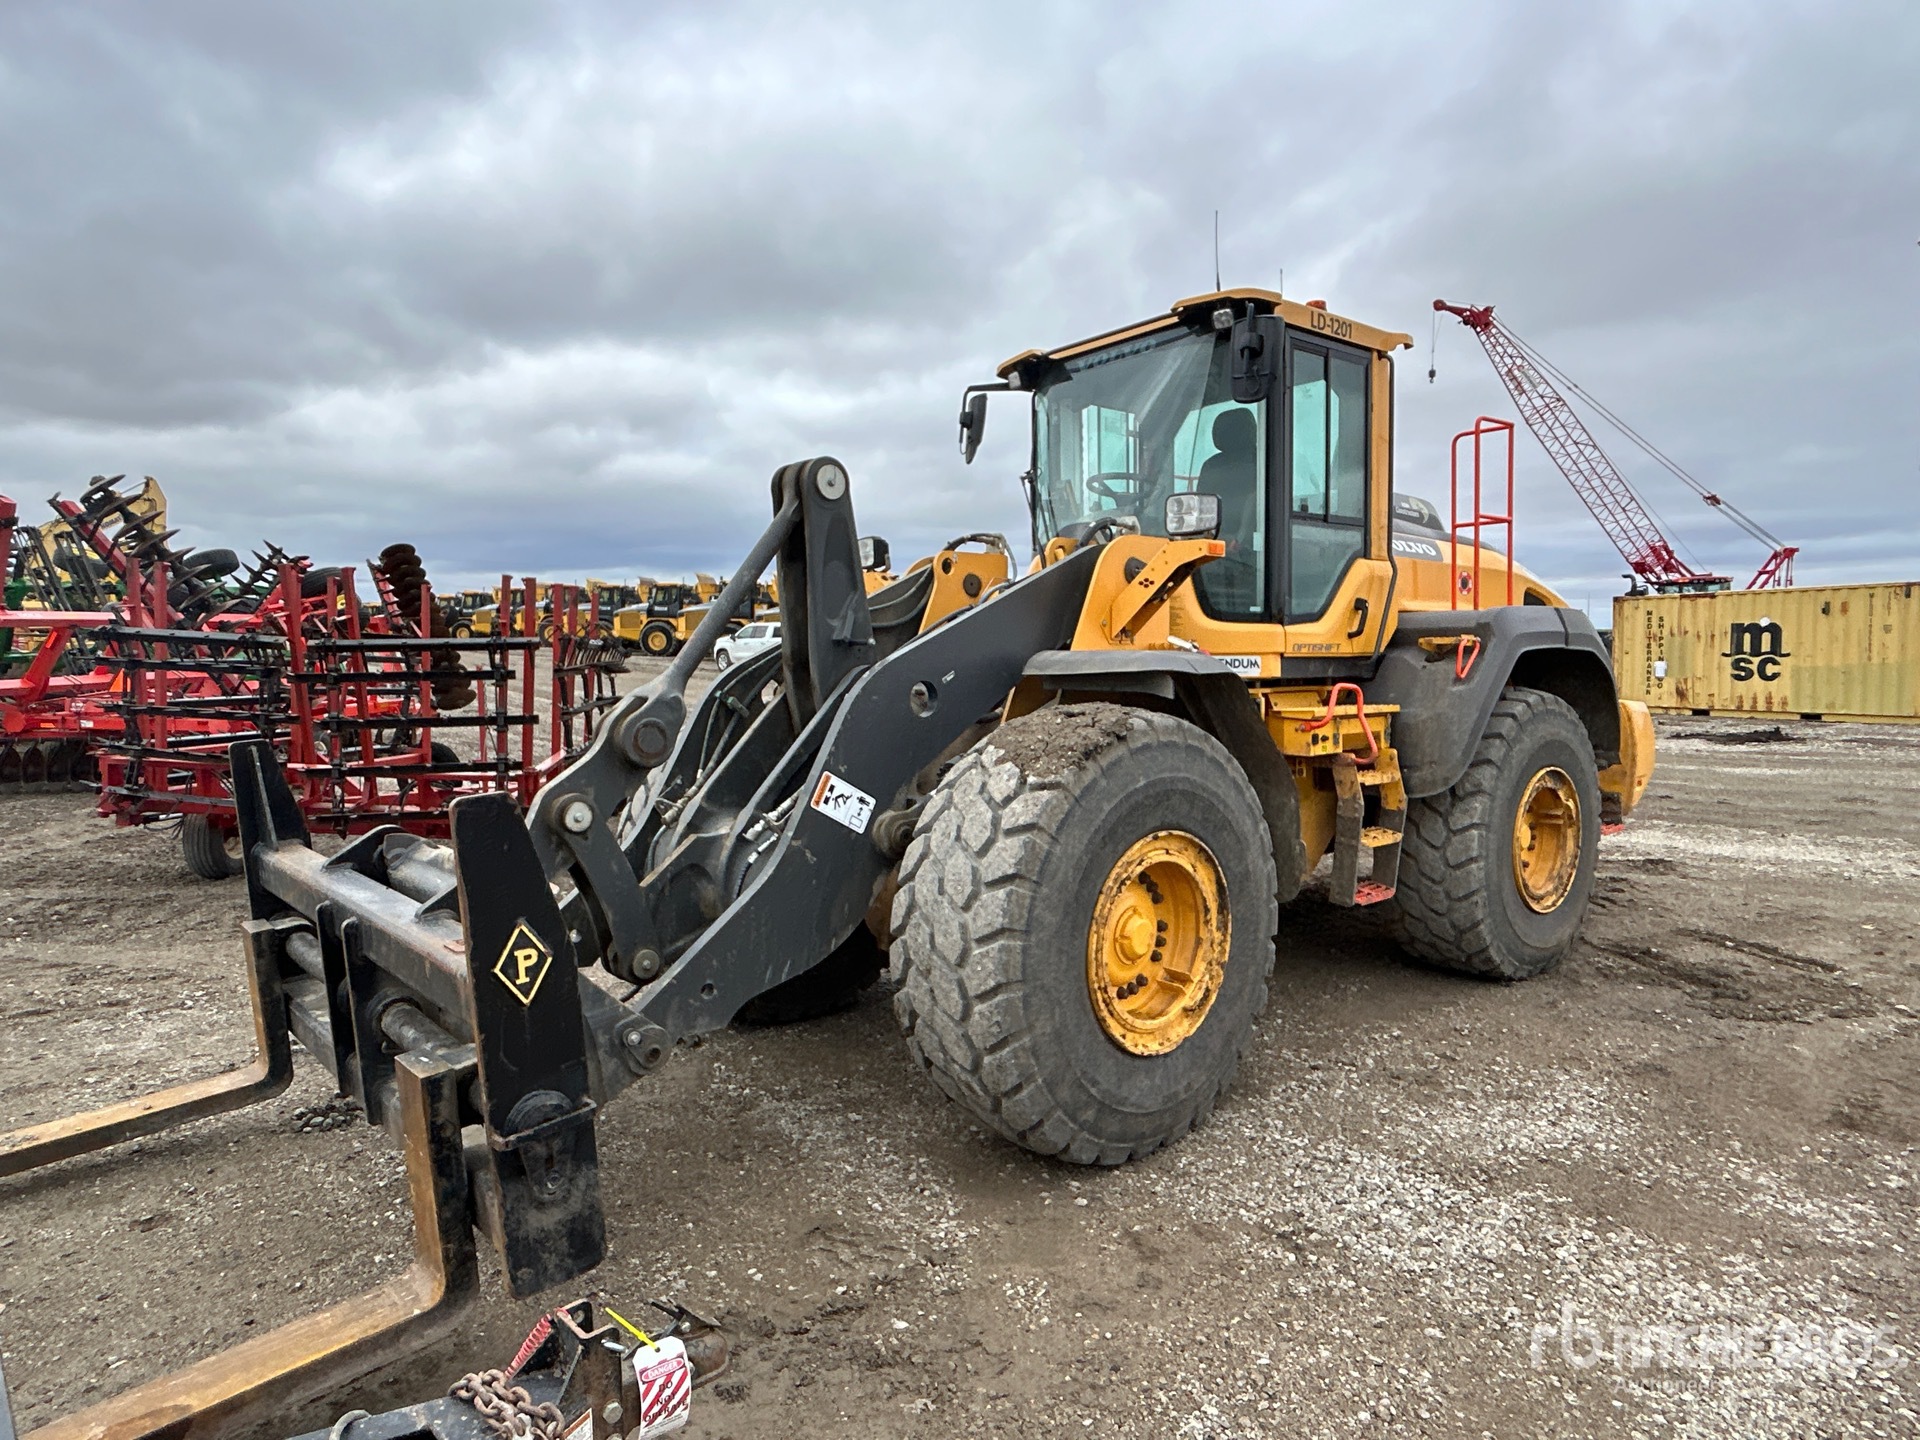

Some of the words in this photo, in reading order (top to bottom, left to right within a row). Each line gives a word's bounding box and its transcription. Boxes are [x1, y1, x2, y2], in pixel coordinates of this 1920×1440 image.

[1310, 310, 1353, 339] LD-1201
[1391, 539, 1437, 556] OLVO
[1292, 643, 1341, 652] OPTISHIFT
[1645, 610, 1653, 695] MEDITERRANEAN
[1219, 658, 1260, 669] NDUM
[513, 947, 539, 985] P
[649, 1361, 678, 1377] DANGER
[658, 1381, 673, 1392] DO
[656, 1392, 675, 1406] NOT
[644, 1400, 686, 1422] OPERATE
